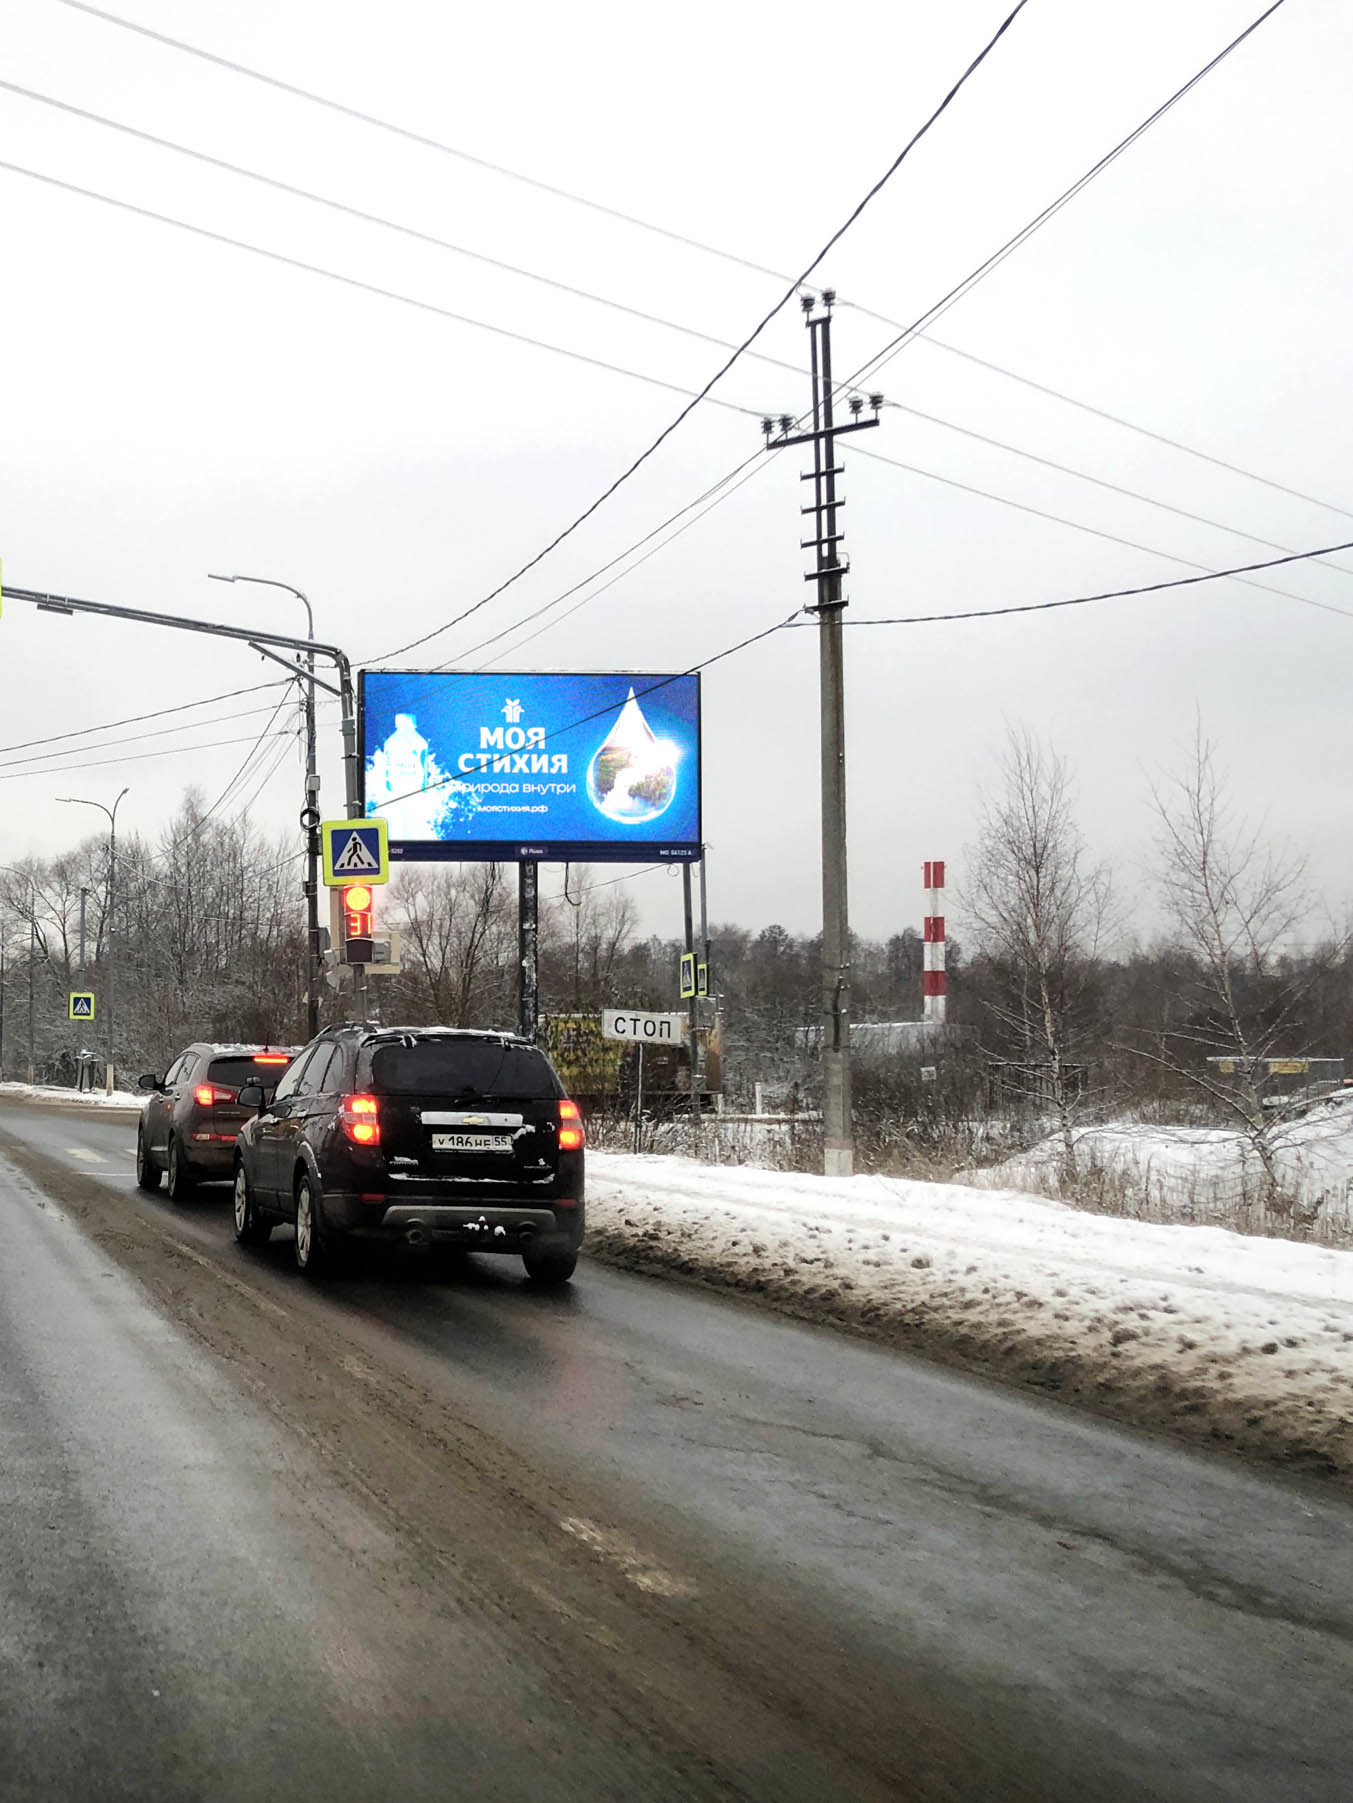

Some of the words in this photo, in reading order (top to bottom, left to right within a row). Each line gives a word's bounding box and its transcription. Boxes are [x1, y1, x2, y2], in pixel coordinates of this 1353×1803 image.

[480, 727, 546, 749] МОЯ
[458, 754, 568, 774] СТИХИЯ
[454, 783, 519, 794] рирода
[522, 783, 576, 795] внутри
[350, 913, 372, 936] 31
[614, 1016, 671, 1038] СТОП
